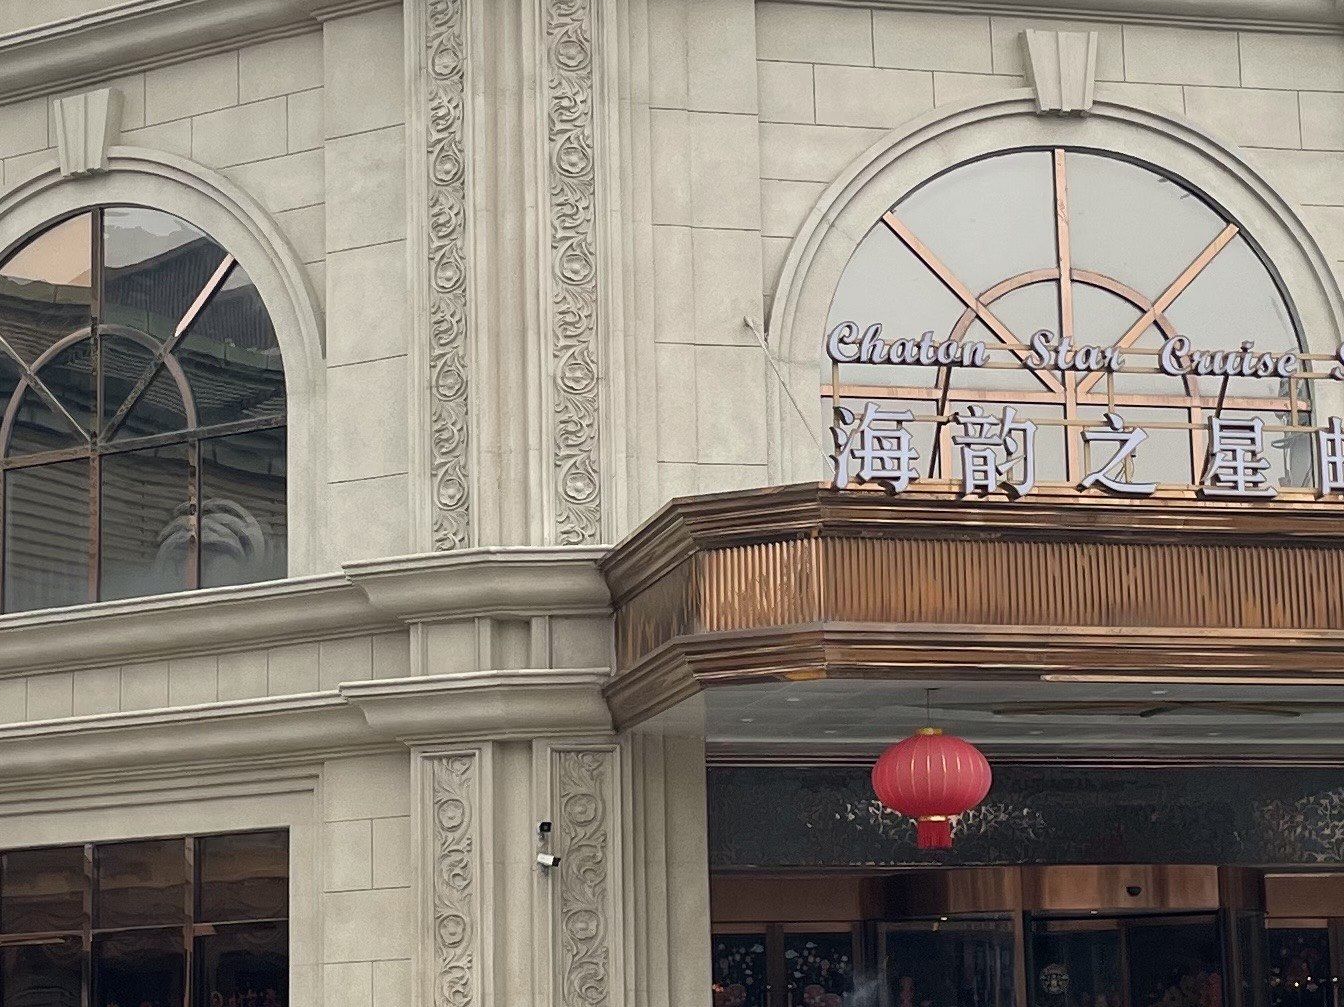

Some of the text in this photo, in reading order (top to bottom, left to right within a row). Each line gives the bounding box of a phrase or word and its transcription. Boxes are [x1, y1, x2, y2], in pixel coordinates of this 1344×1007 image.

[827, 320, 990, 367] Chaton
[1025, 329, 1125, 373] Star
[1158, 334, 1298, 377] Cruise
